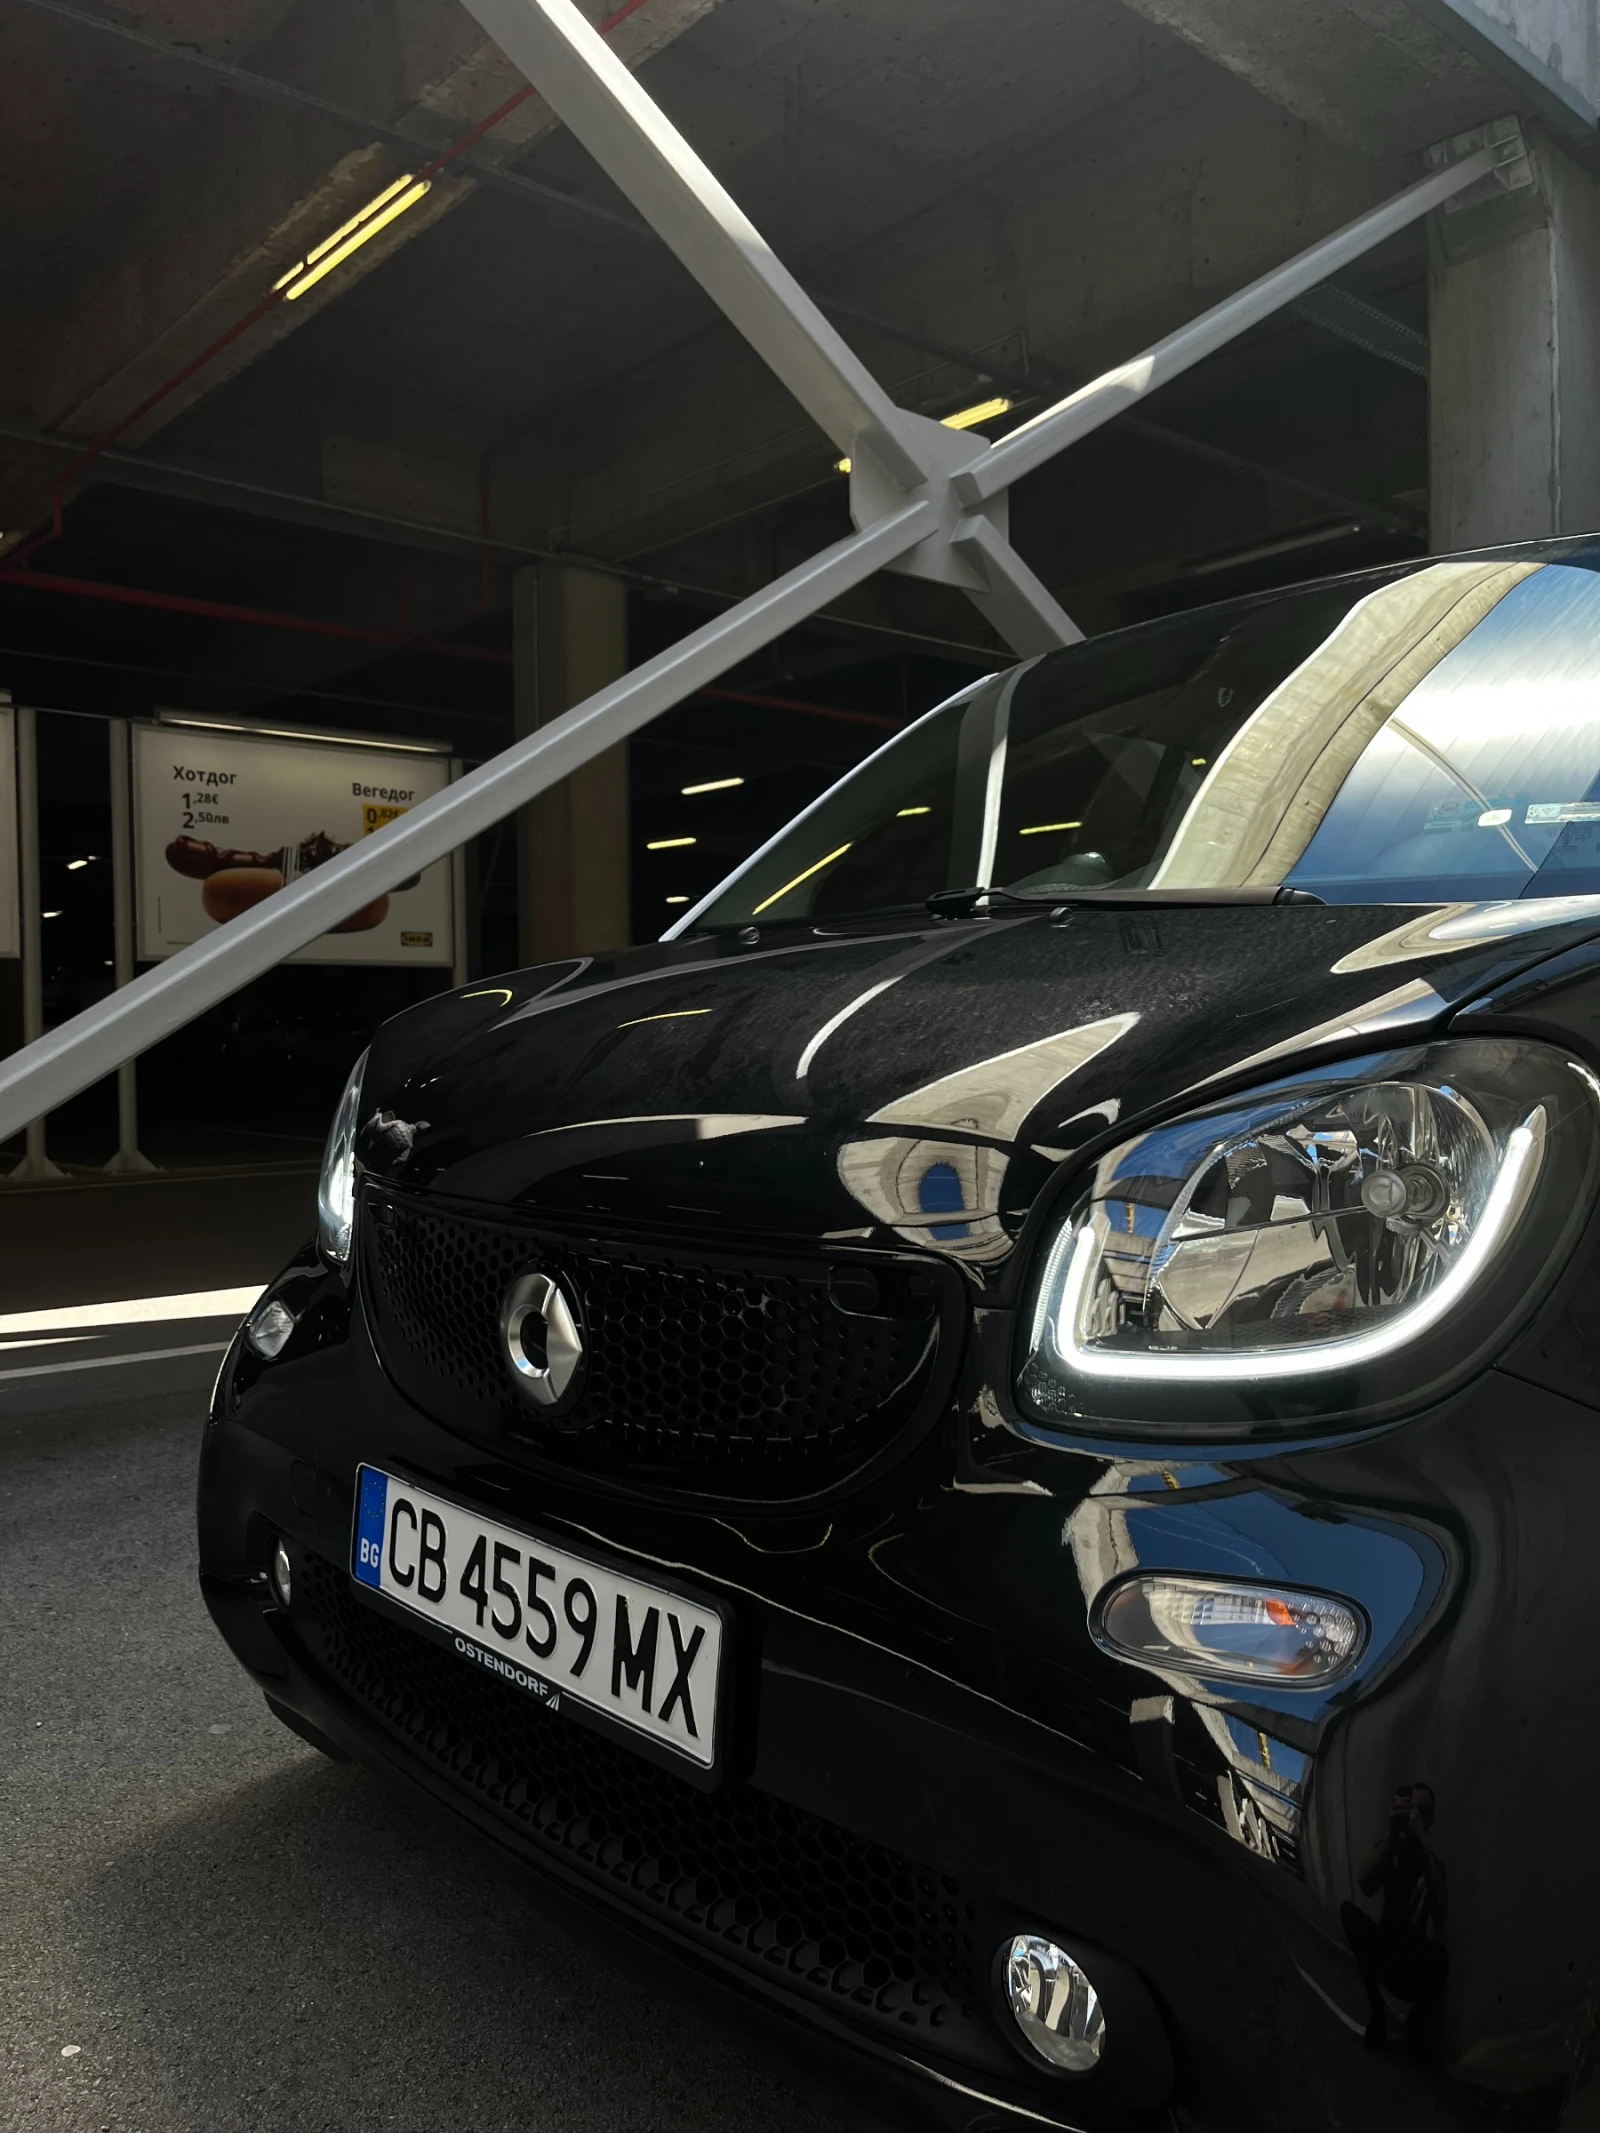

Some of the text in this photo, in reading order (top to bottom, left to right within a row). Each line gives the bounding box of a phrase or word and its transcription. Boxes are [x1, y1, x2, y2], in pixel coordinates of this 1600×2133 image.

[173, 765, 237, 787] Хотдог
[182, 792, 219, 809] 1,28€
[352, 782, 415, 803] Вегедог
[183, 811, 230, 829] 2,50лв
[360, 1538, 379, 1568] BG
[460, 1534, 597, 1678] 4559
[455, 1636, 549, 1697] OSTENDORF
